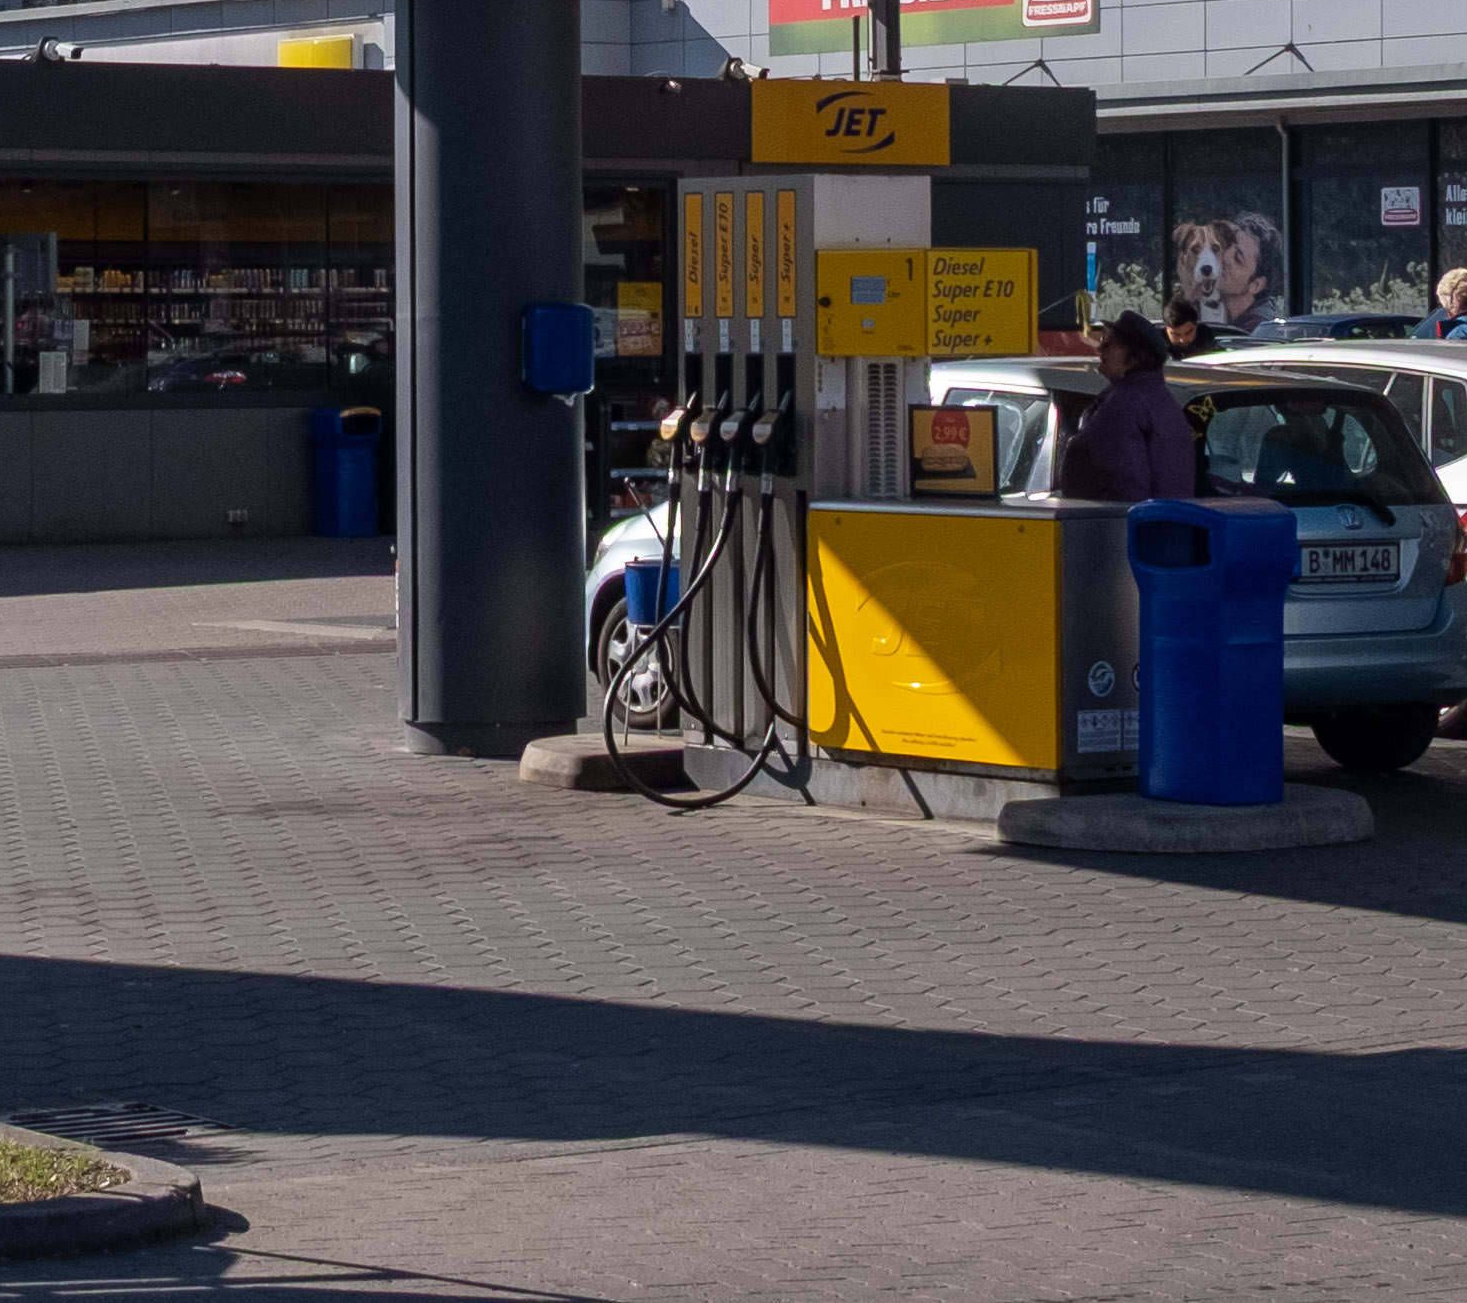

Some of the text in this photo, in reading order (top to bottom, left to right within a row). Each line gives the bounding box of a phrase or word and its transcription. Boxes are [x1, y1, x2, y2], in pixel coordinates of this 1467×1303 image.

[1027, 1, 1088, 20] FRESSNAPF
[825, 107, 887, 138] JET
[1093, 196, 1110, 214] für
[718, 202, 732, 285] Super E10
[688, 231, 700, 285] Diesel
[749, 235, 763, 285] Super
[905, 257, 914, 282] 1
[933, 257, 985, 276] Diesel
[932, 280, 1015, 303] Super E10
[932, 305, 980, 327] Super
[932, 330, 980, 353] Super
